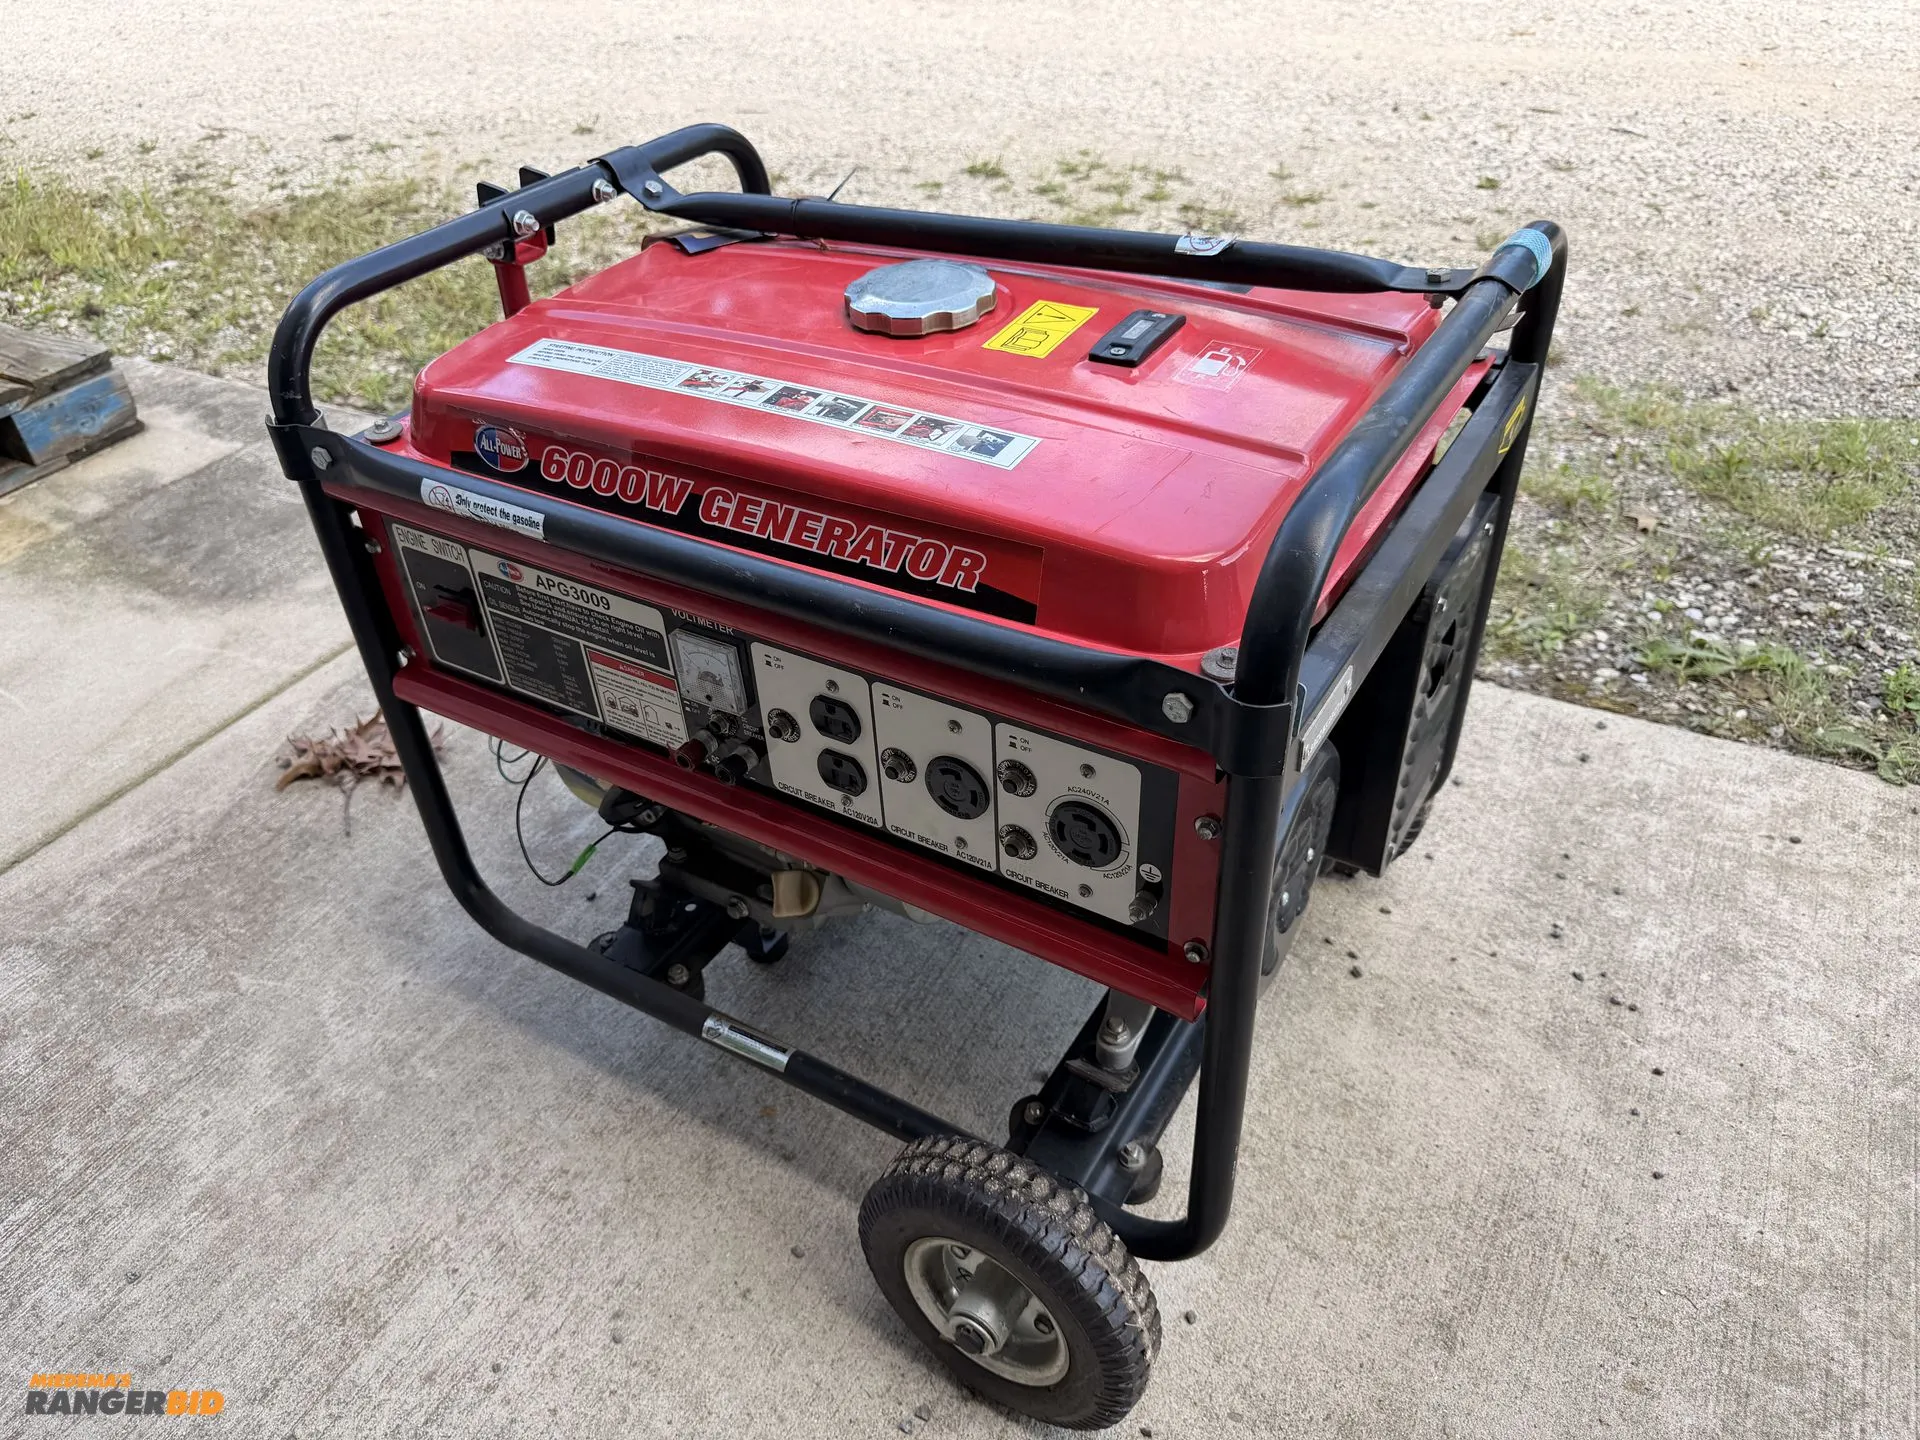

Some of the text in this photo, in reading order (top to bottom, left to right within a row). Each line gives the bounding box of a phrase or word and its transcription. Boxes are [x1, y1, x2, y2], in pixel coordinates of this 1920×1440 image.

[480, 434, 522, 460] ALL-POWER
[473, 502, 498, 517] protect
[499, 507, 511, 521] the
[512, 513, 541, 531] gasoline
[540, 445, 989, 595] 6000W GENERATOR
[395, 526, 465, 563] ENGINE SWITCH
[535, 574, 611, 611] APG3009
[610, 617, 634, 631] Engine
[634, 625, 645, 635] Oil
[645, 630, 660, 640] with
[671, 608, 734, 636] VOLTMETER
[1019, 737, 1030, 745] ON
[1020, 745, 1032, 753] OFF
[778, 781, 836, 810] CIRCUIT BREAKER
[1067, 786, 1111, 806] AC240V21A
[890, 824, 949, 852] CIRCUIT BREAKER
[956, 850, 993, 870] AC120V21A
[1005, 868, 1069, 900] CIRCUIT BREAKER
